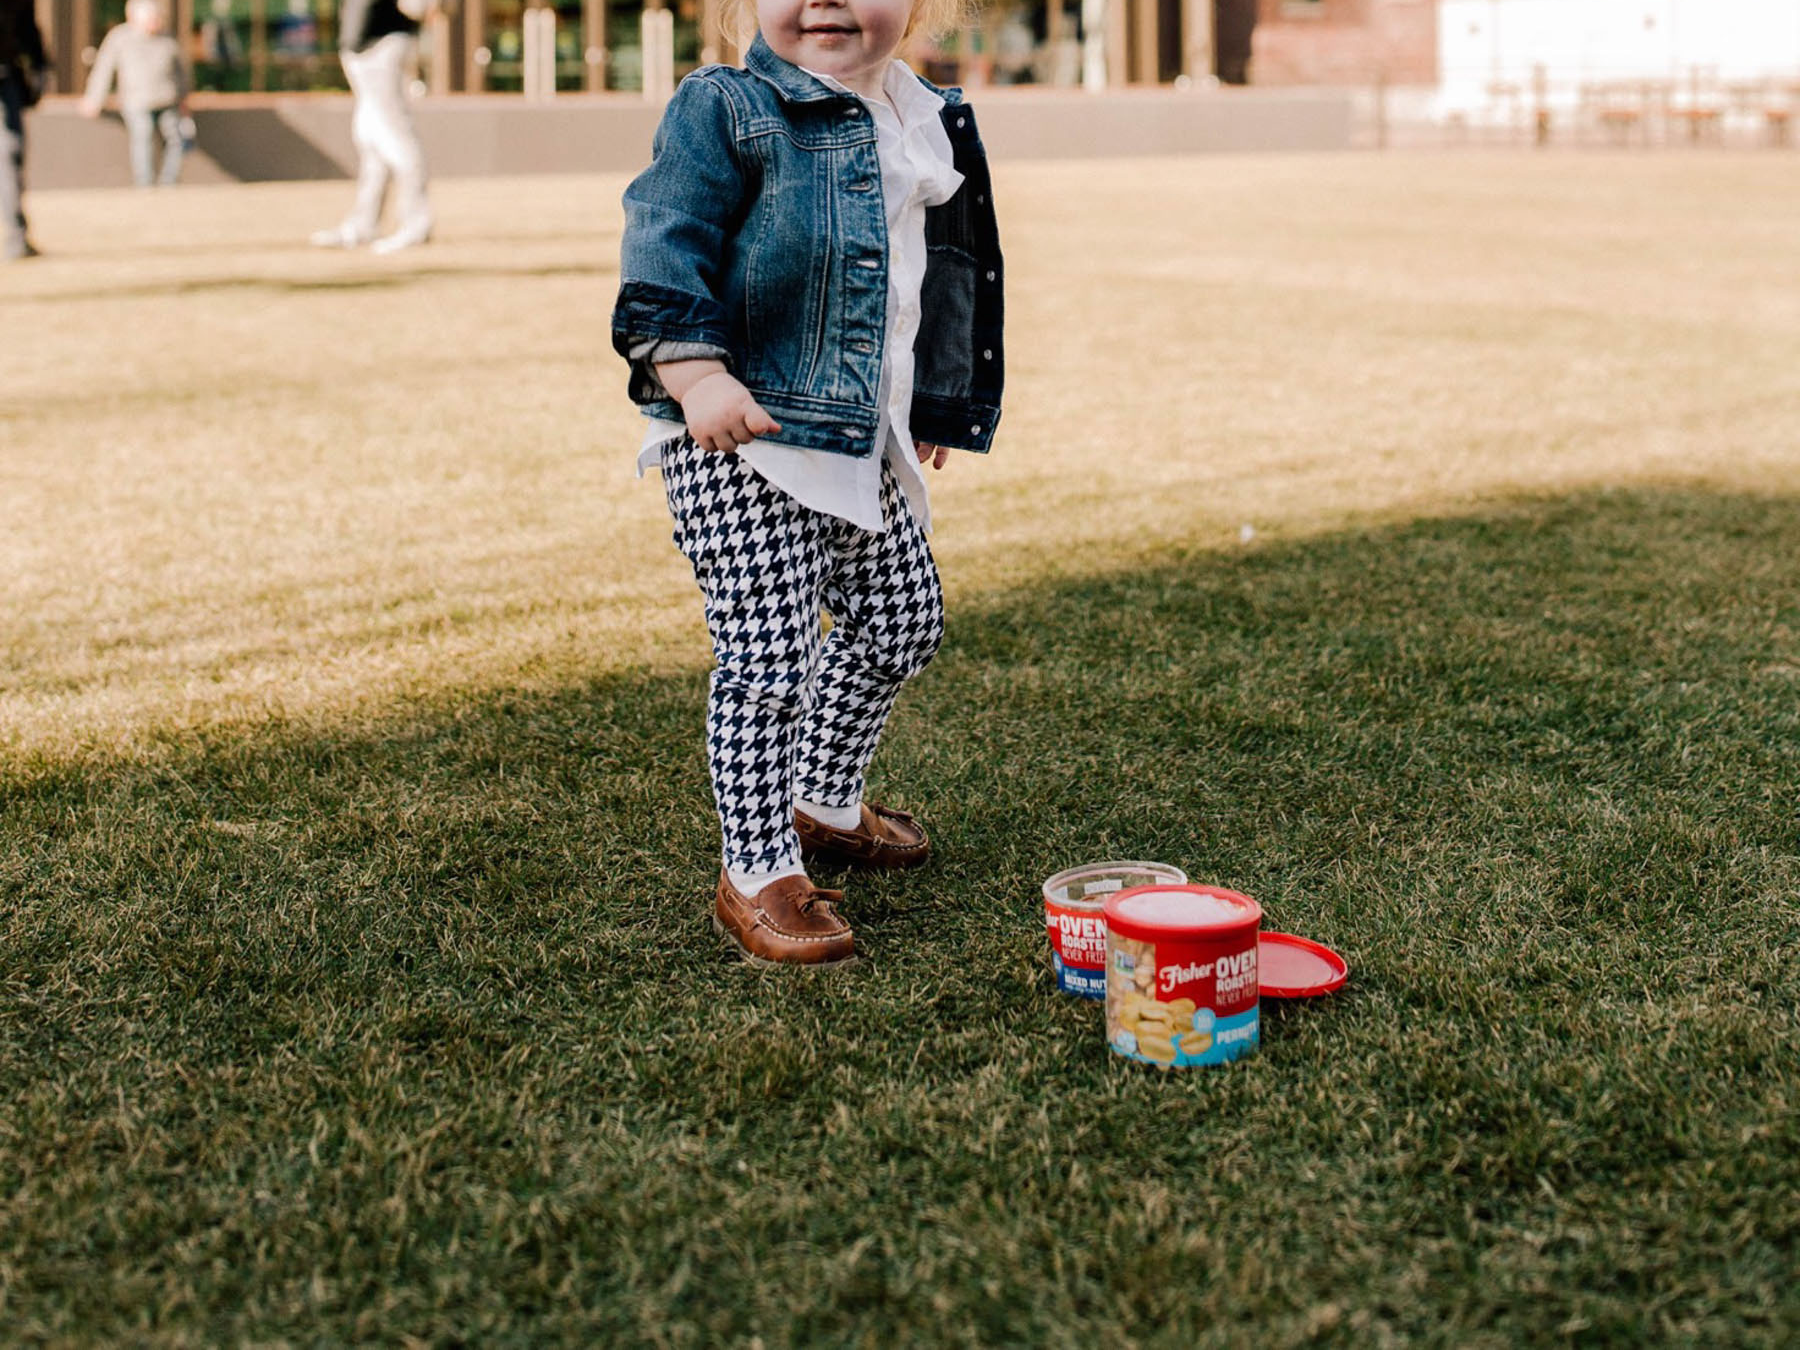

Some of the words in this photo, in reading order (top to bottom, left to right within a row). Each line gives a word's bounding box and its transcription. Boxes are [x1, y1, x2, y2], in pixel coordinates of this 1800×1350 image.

[1059, 914, 1107, 938] OVEN
[1159, 962, 1213, 993] Fisher
[1216, 946, 1257, 979] OVEN
